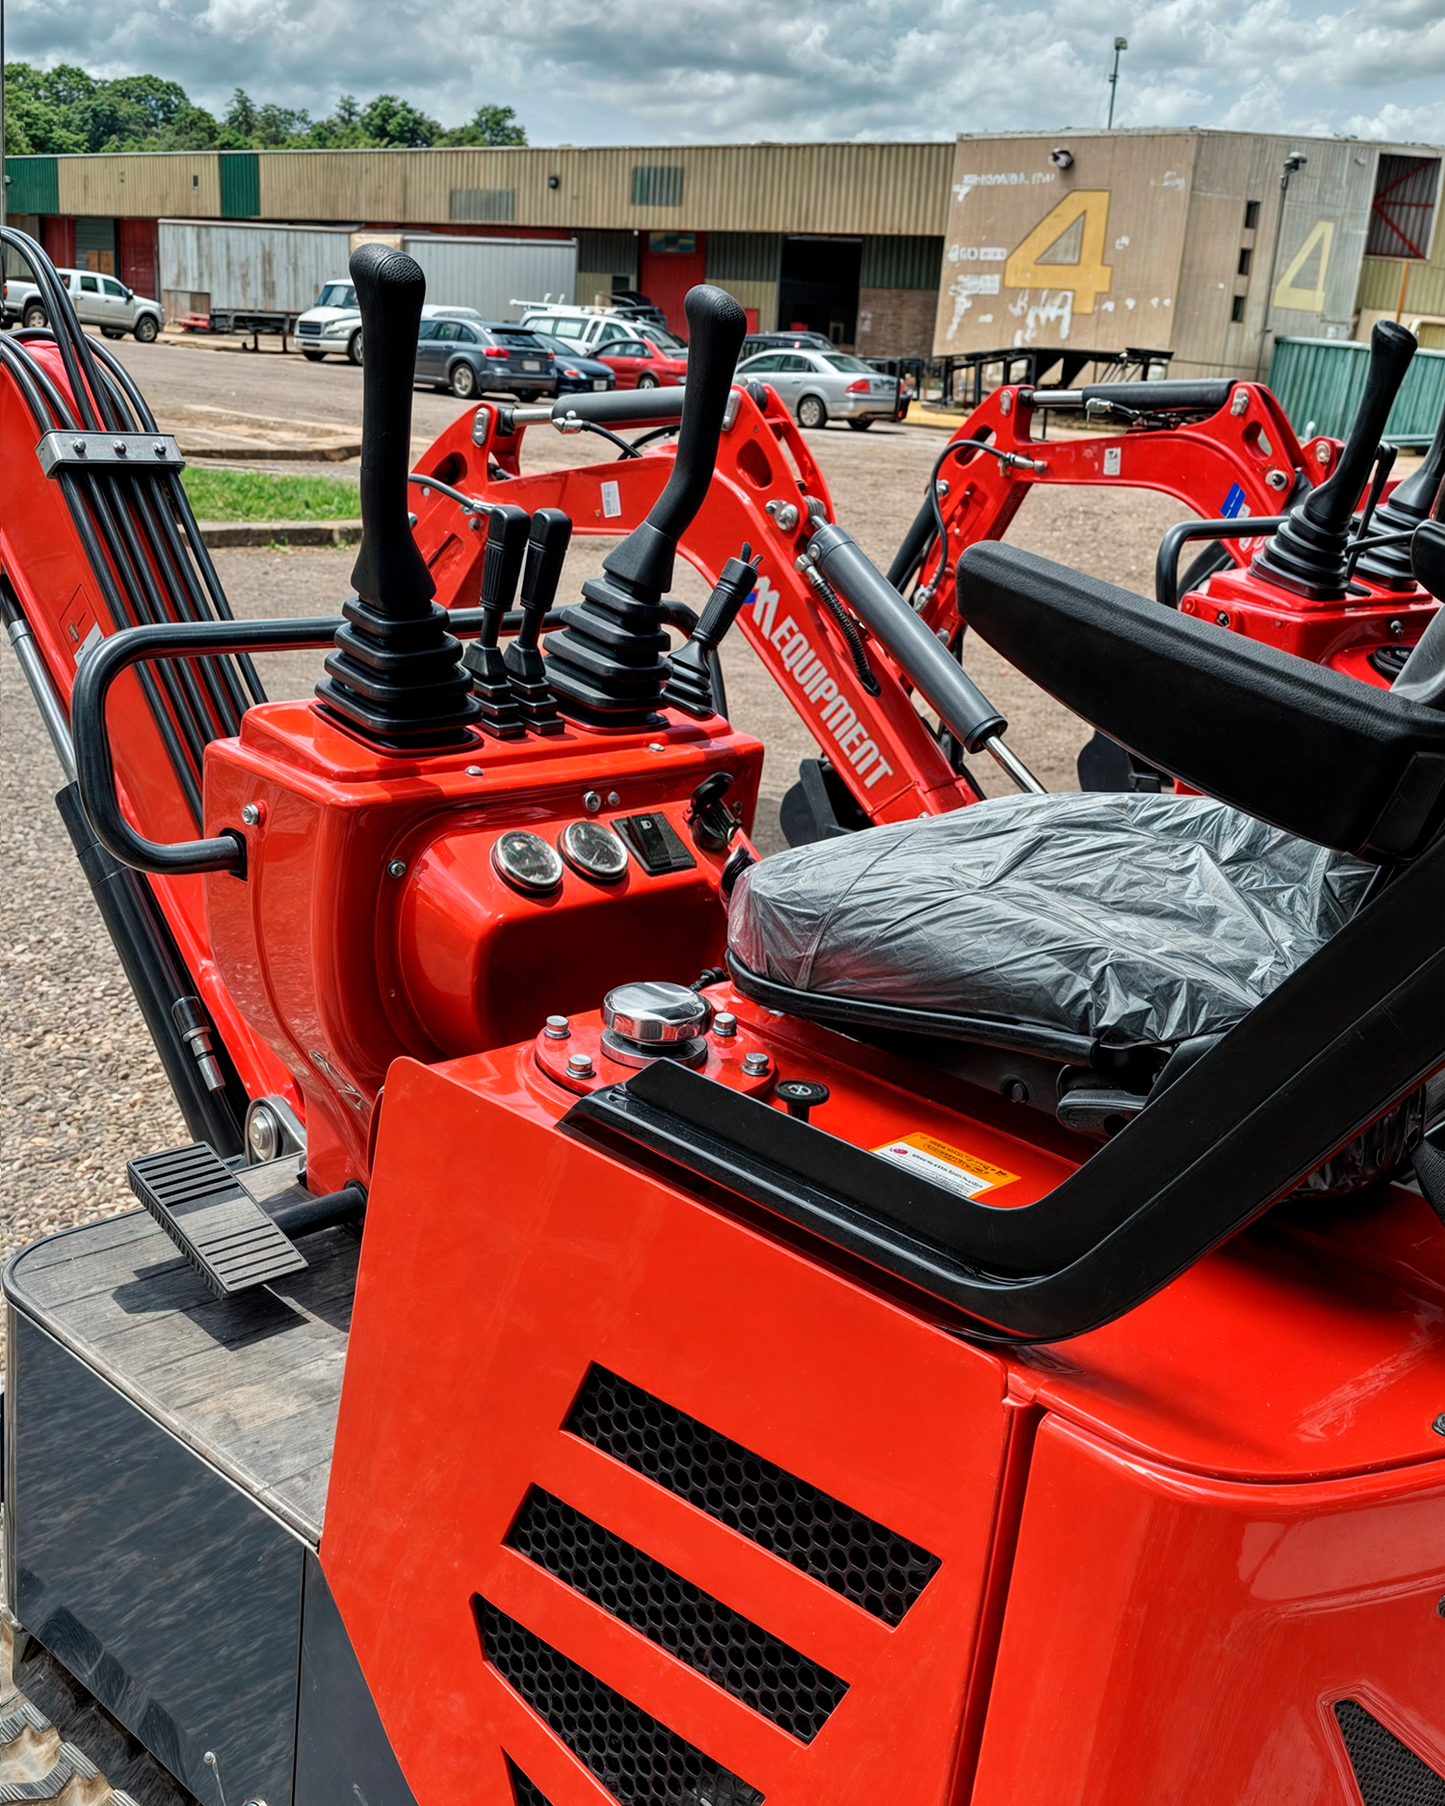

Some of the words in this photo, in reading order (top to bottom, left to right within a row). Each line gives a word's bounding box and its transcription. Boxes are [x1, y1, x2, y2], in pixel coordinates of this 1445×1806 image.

[1004, 189, 1113, 314] 4
[1273, 220, 1335, 312] 4
[770, 615, 894, 789] EQUIPMENT
